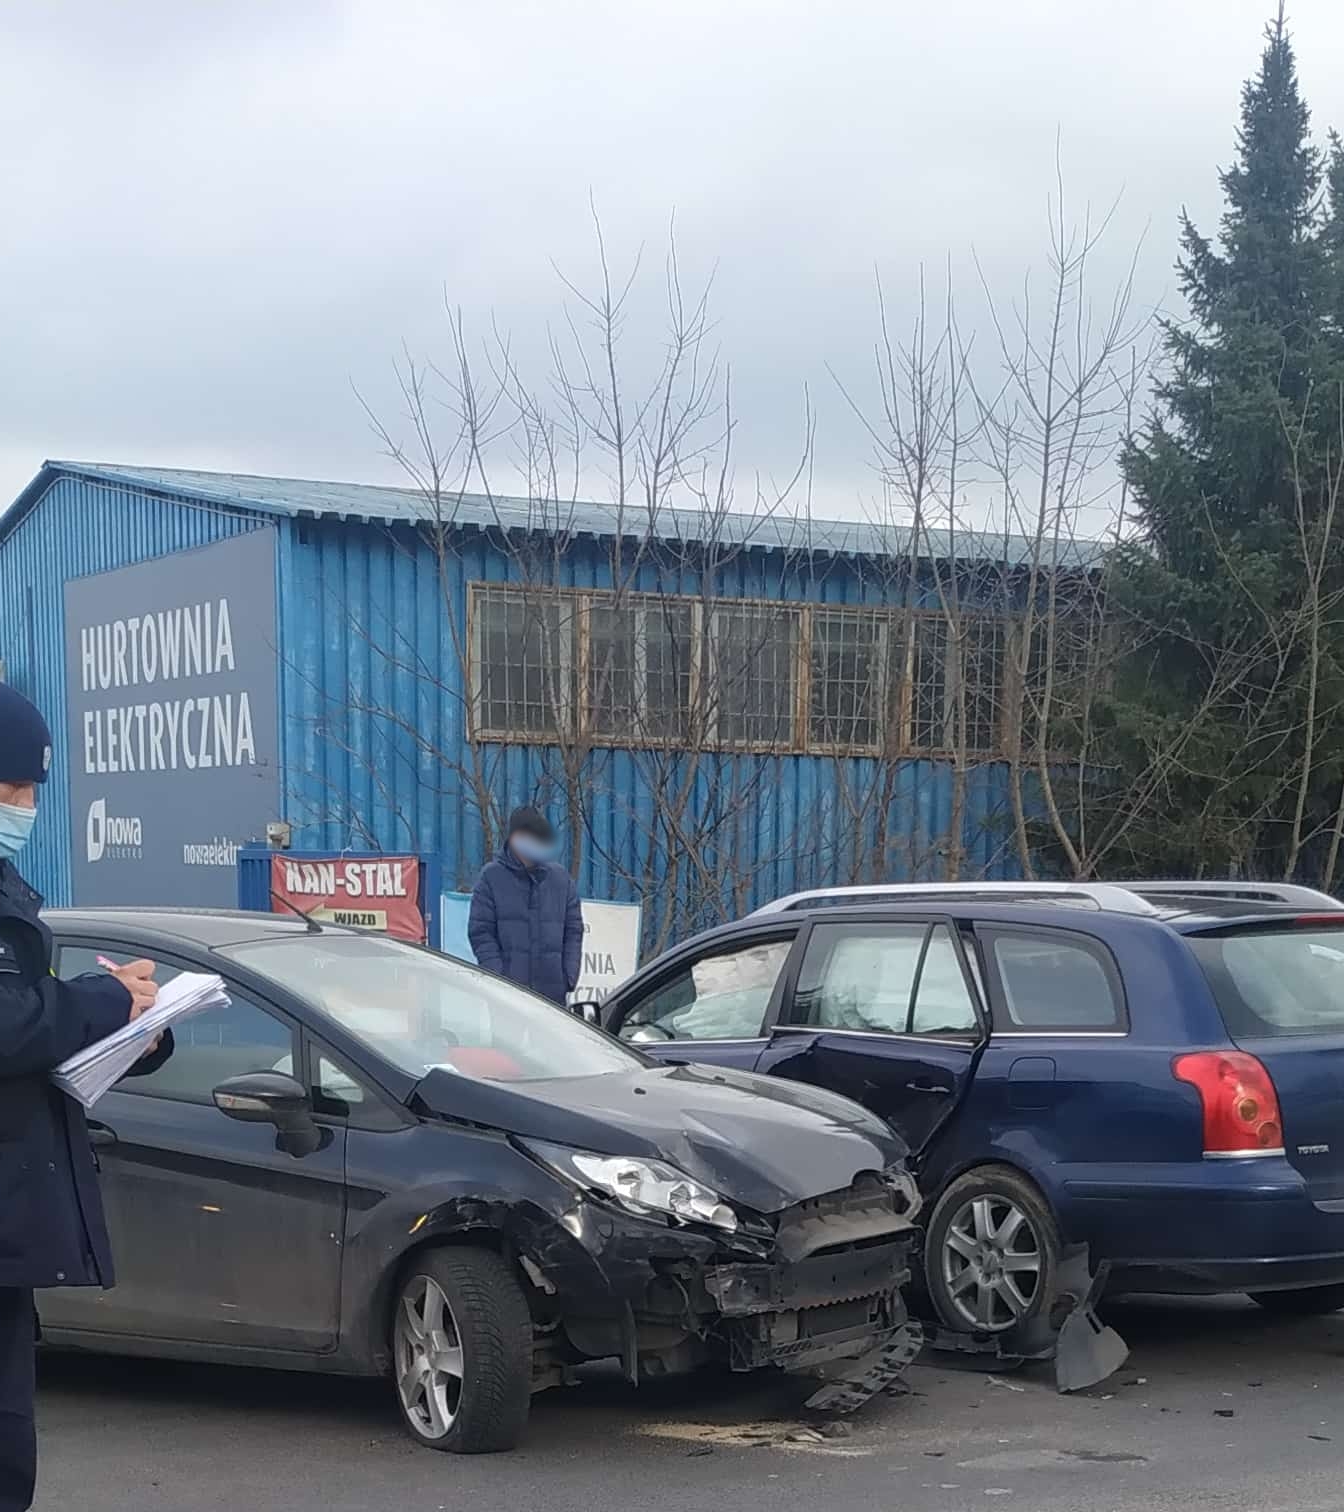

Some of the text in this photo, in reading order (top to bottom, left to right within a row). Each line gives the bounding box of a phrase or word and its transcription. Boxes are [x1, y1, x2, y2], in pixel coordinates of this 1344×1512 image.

[81, 598, 236, 692] HURTOWNIA
[84, 691, 257, 774] ELEKTRYCZNA
[106, 816, 142, 846] nowa
[285, 861, 407, 896] KAN-STAL
[334, 911, 377, 926] WJAZD
[584, 952, 617, 975] NIA
